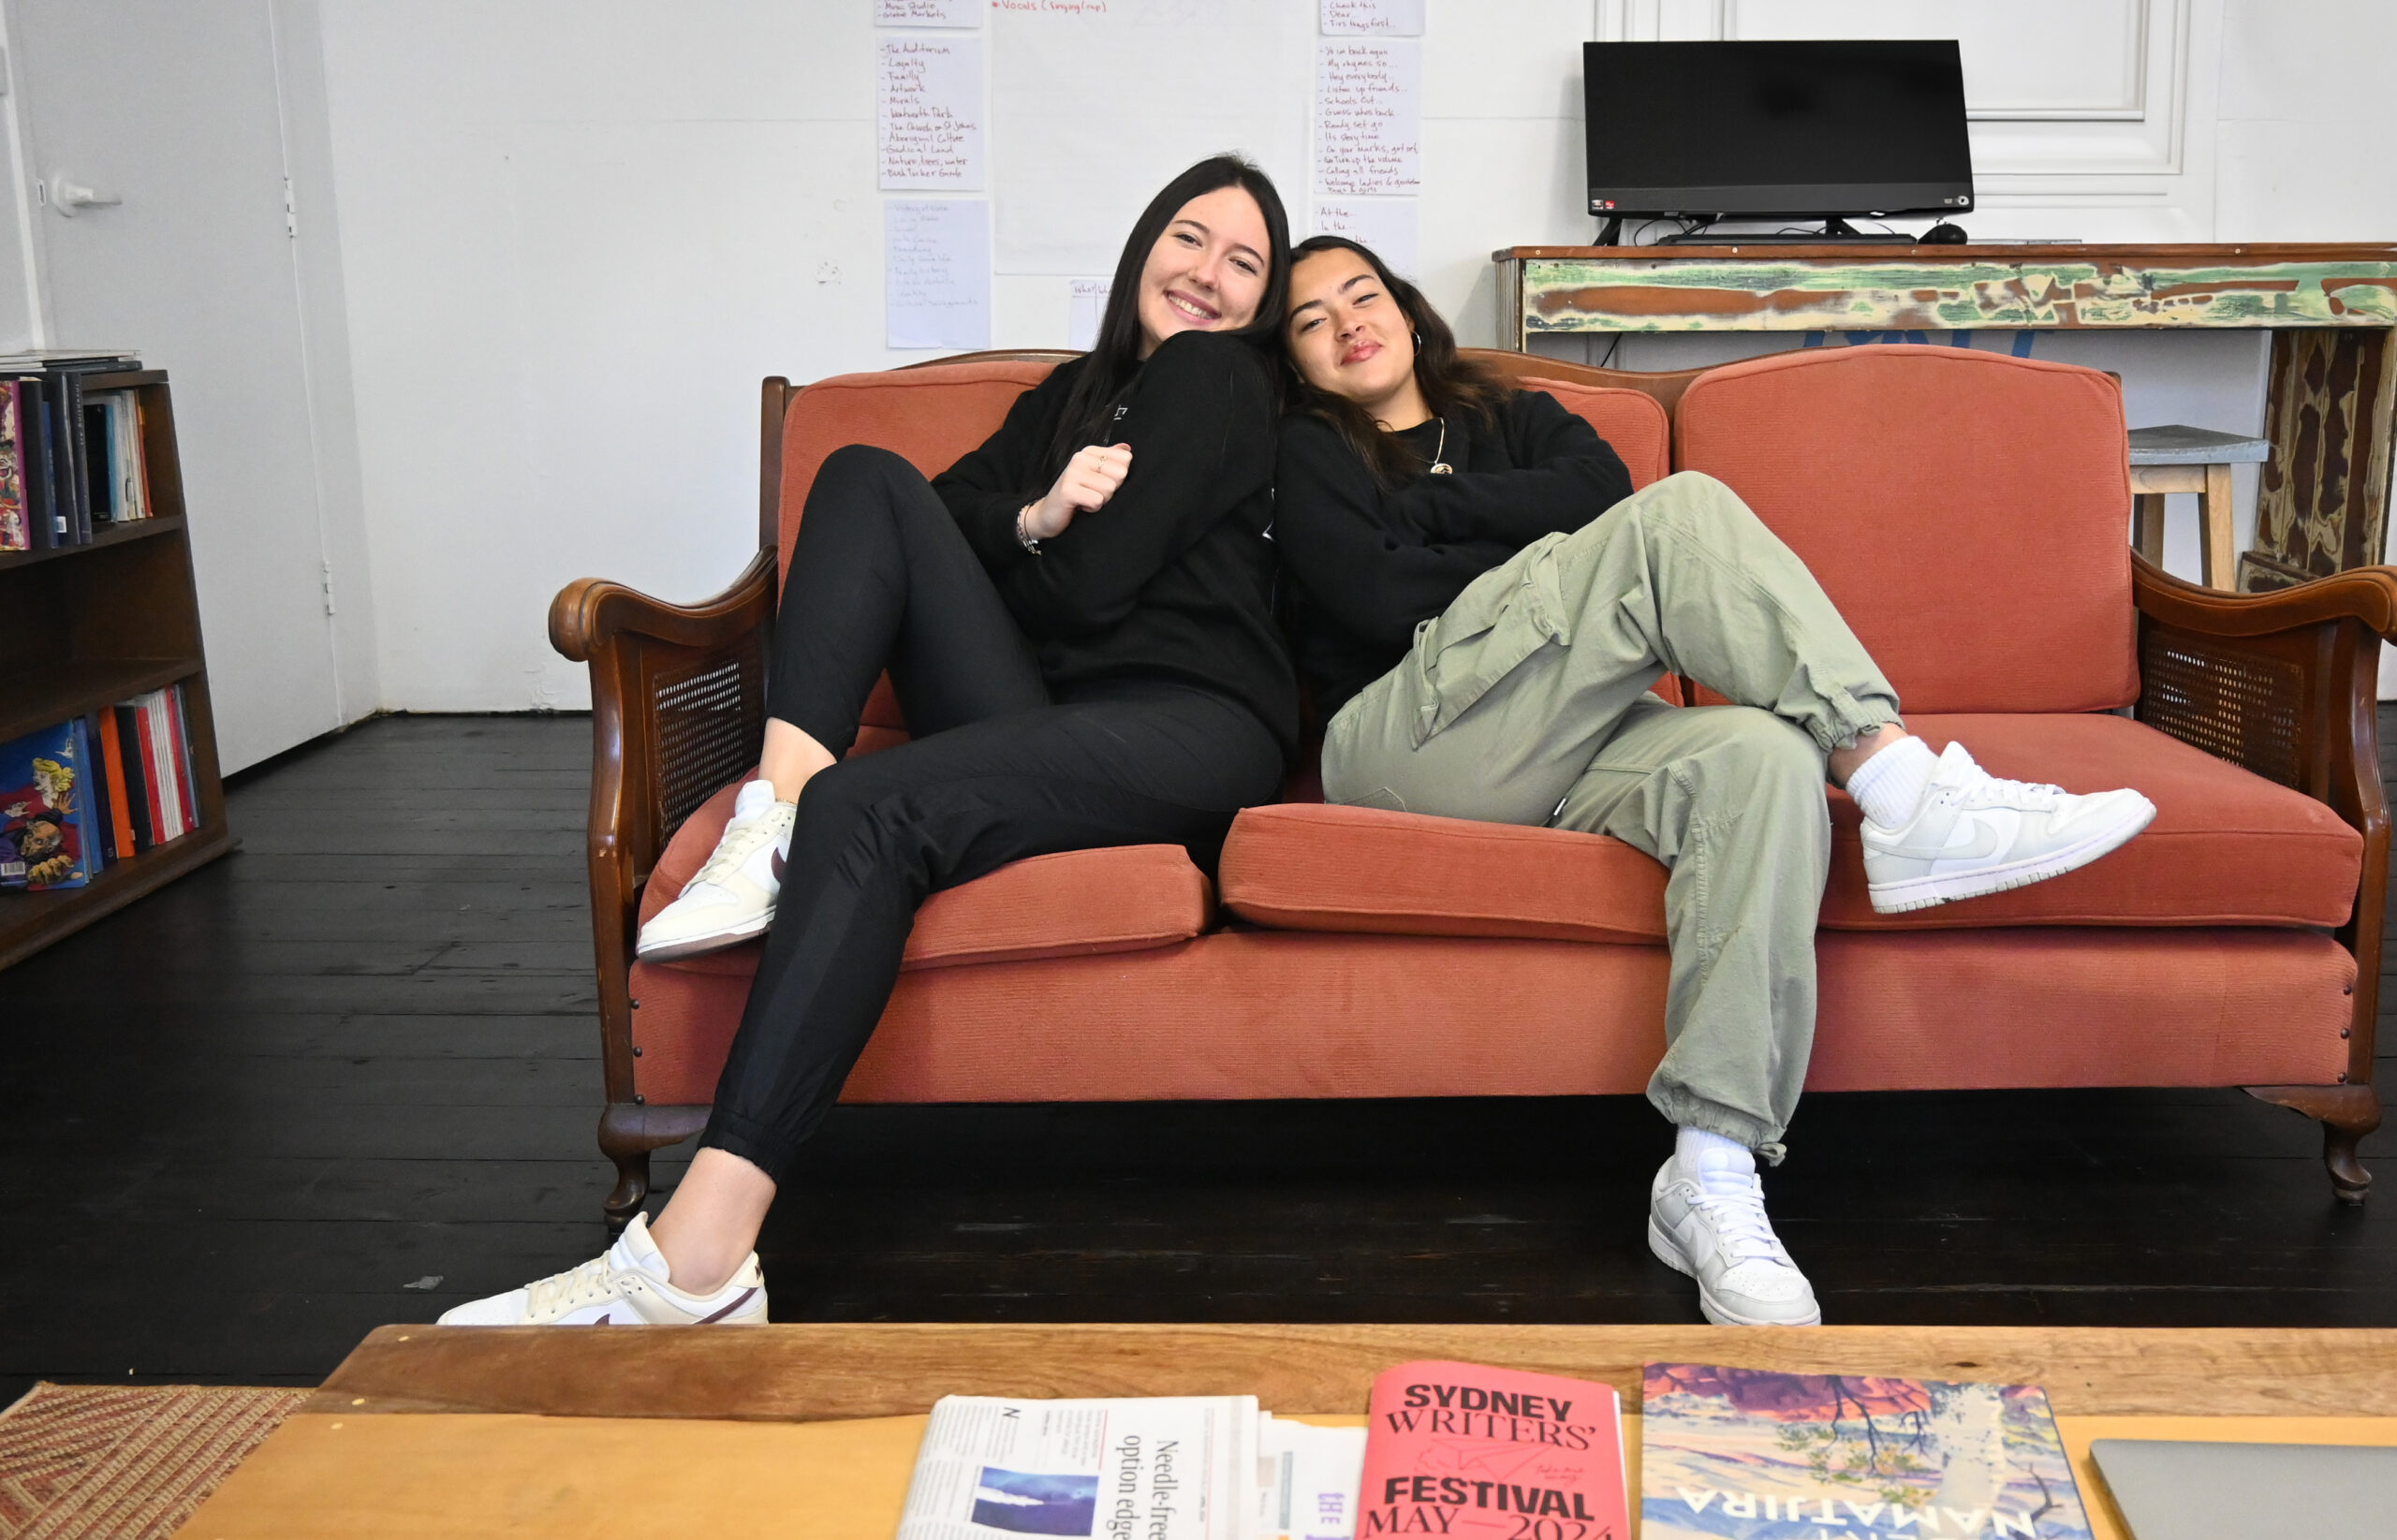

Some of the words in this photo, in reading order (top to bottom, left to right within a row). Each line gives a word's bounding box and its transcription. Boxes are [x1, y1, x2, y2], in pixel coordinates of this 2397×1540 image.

[889, 57, 926, 74] Loyalty
[931, 144, 954, 154] Land
[1404, 1384, 1572, 1422] SYDNEY
[1115, 1435, 1144, 1493] option
[1148, 1441, 1179, 1540] Needle-free
[1383, 1475, 1596, 1521] FESTIVAL
[1362, 1504, 1461, 1540] MAY
[1675, 1486, 2037, 1538] NAMATJIRA
